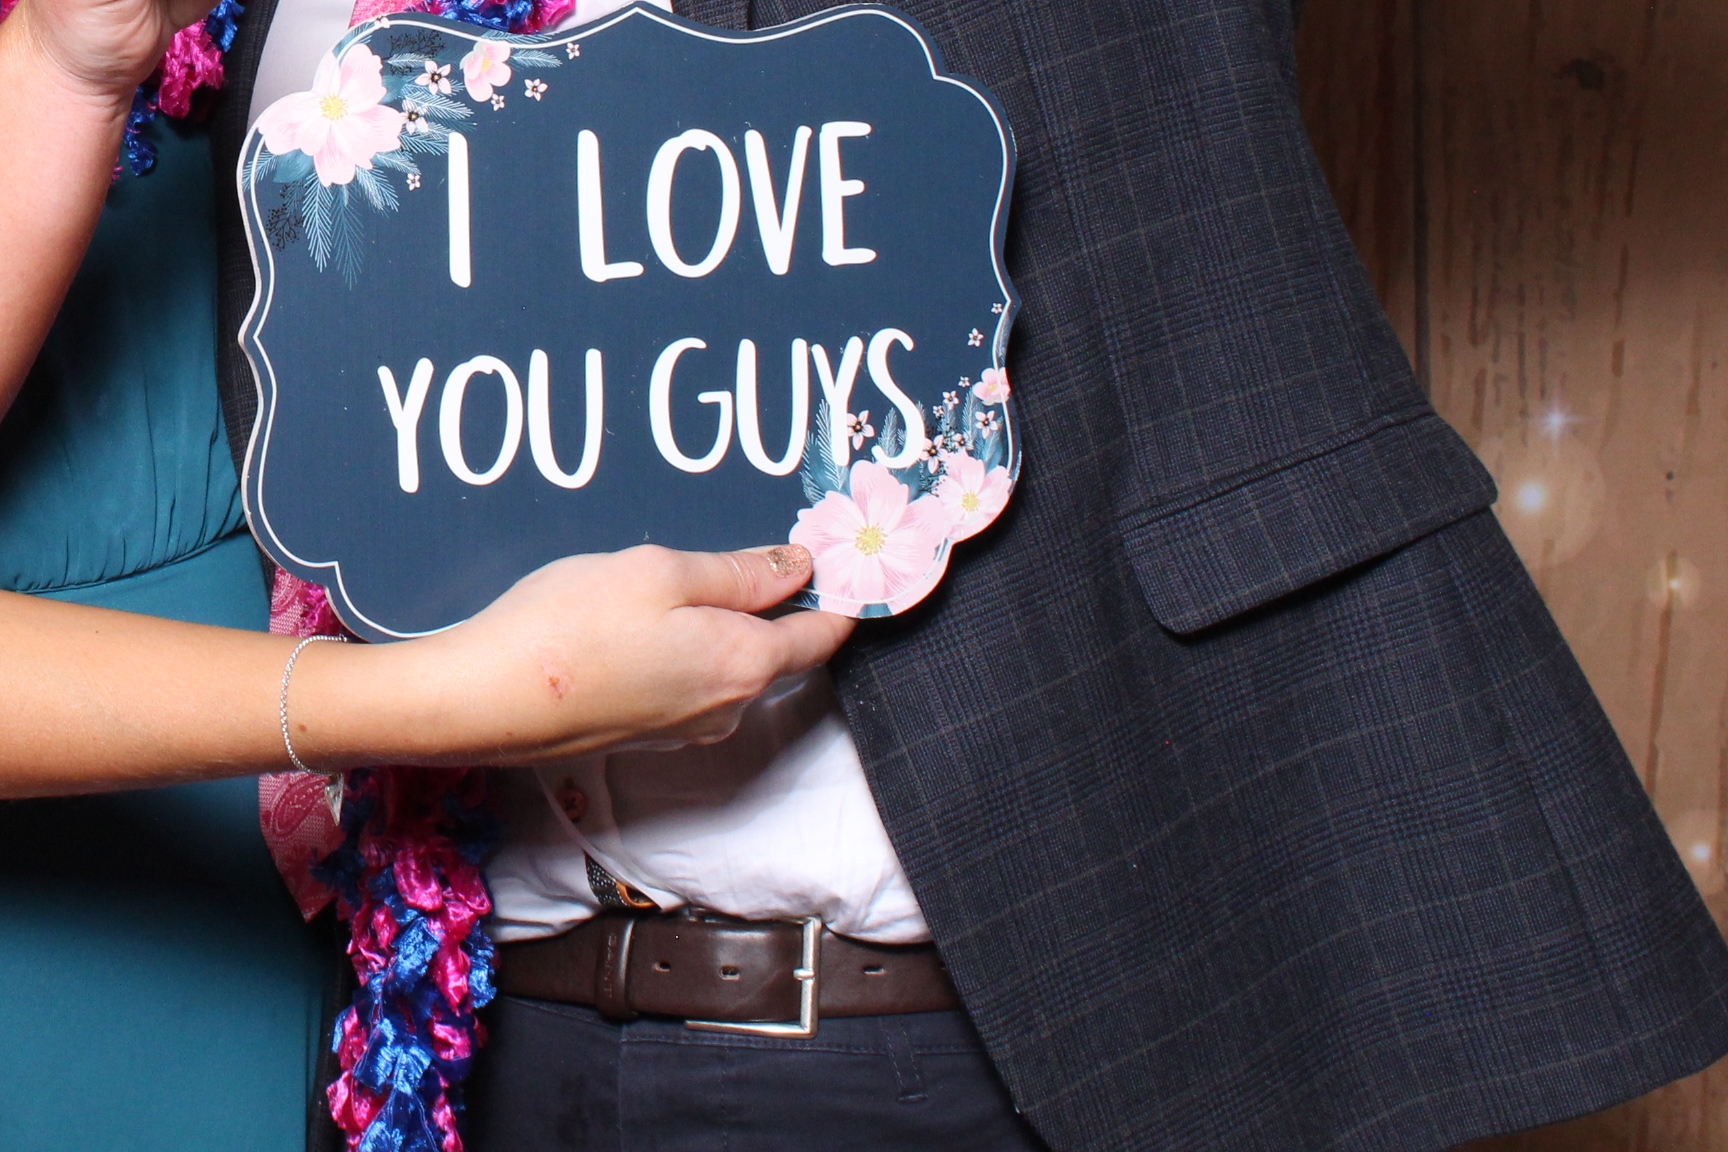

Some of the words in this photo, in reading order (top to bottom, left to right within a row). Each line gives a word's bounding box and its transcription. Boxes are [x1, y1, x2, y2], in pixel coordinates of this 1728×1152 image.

[448, 131, 472, 289] I
[576, 120, 877, 283] LOVE
[377, 348, 604, 494] YOU
[648, 327, 925, 477] GUYS
